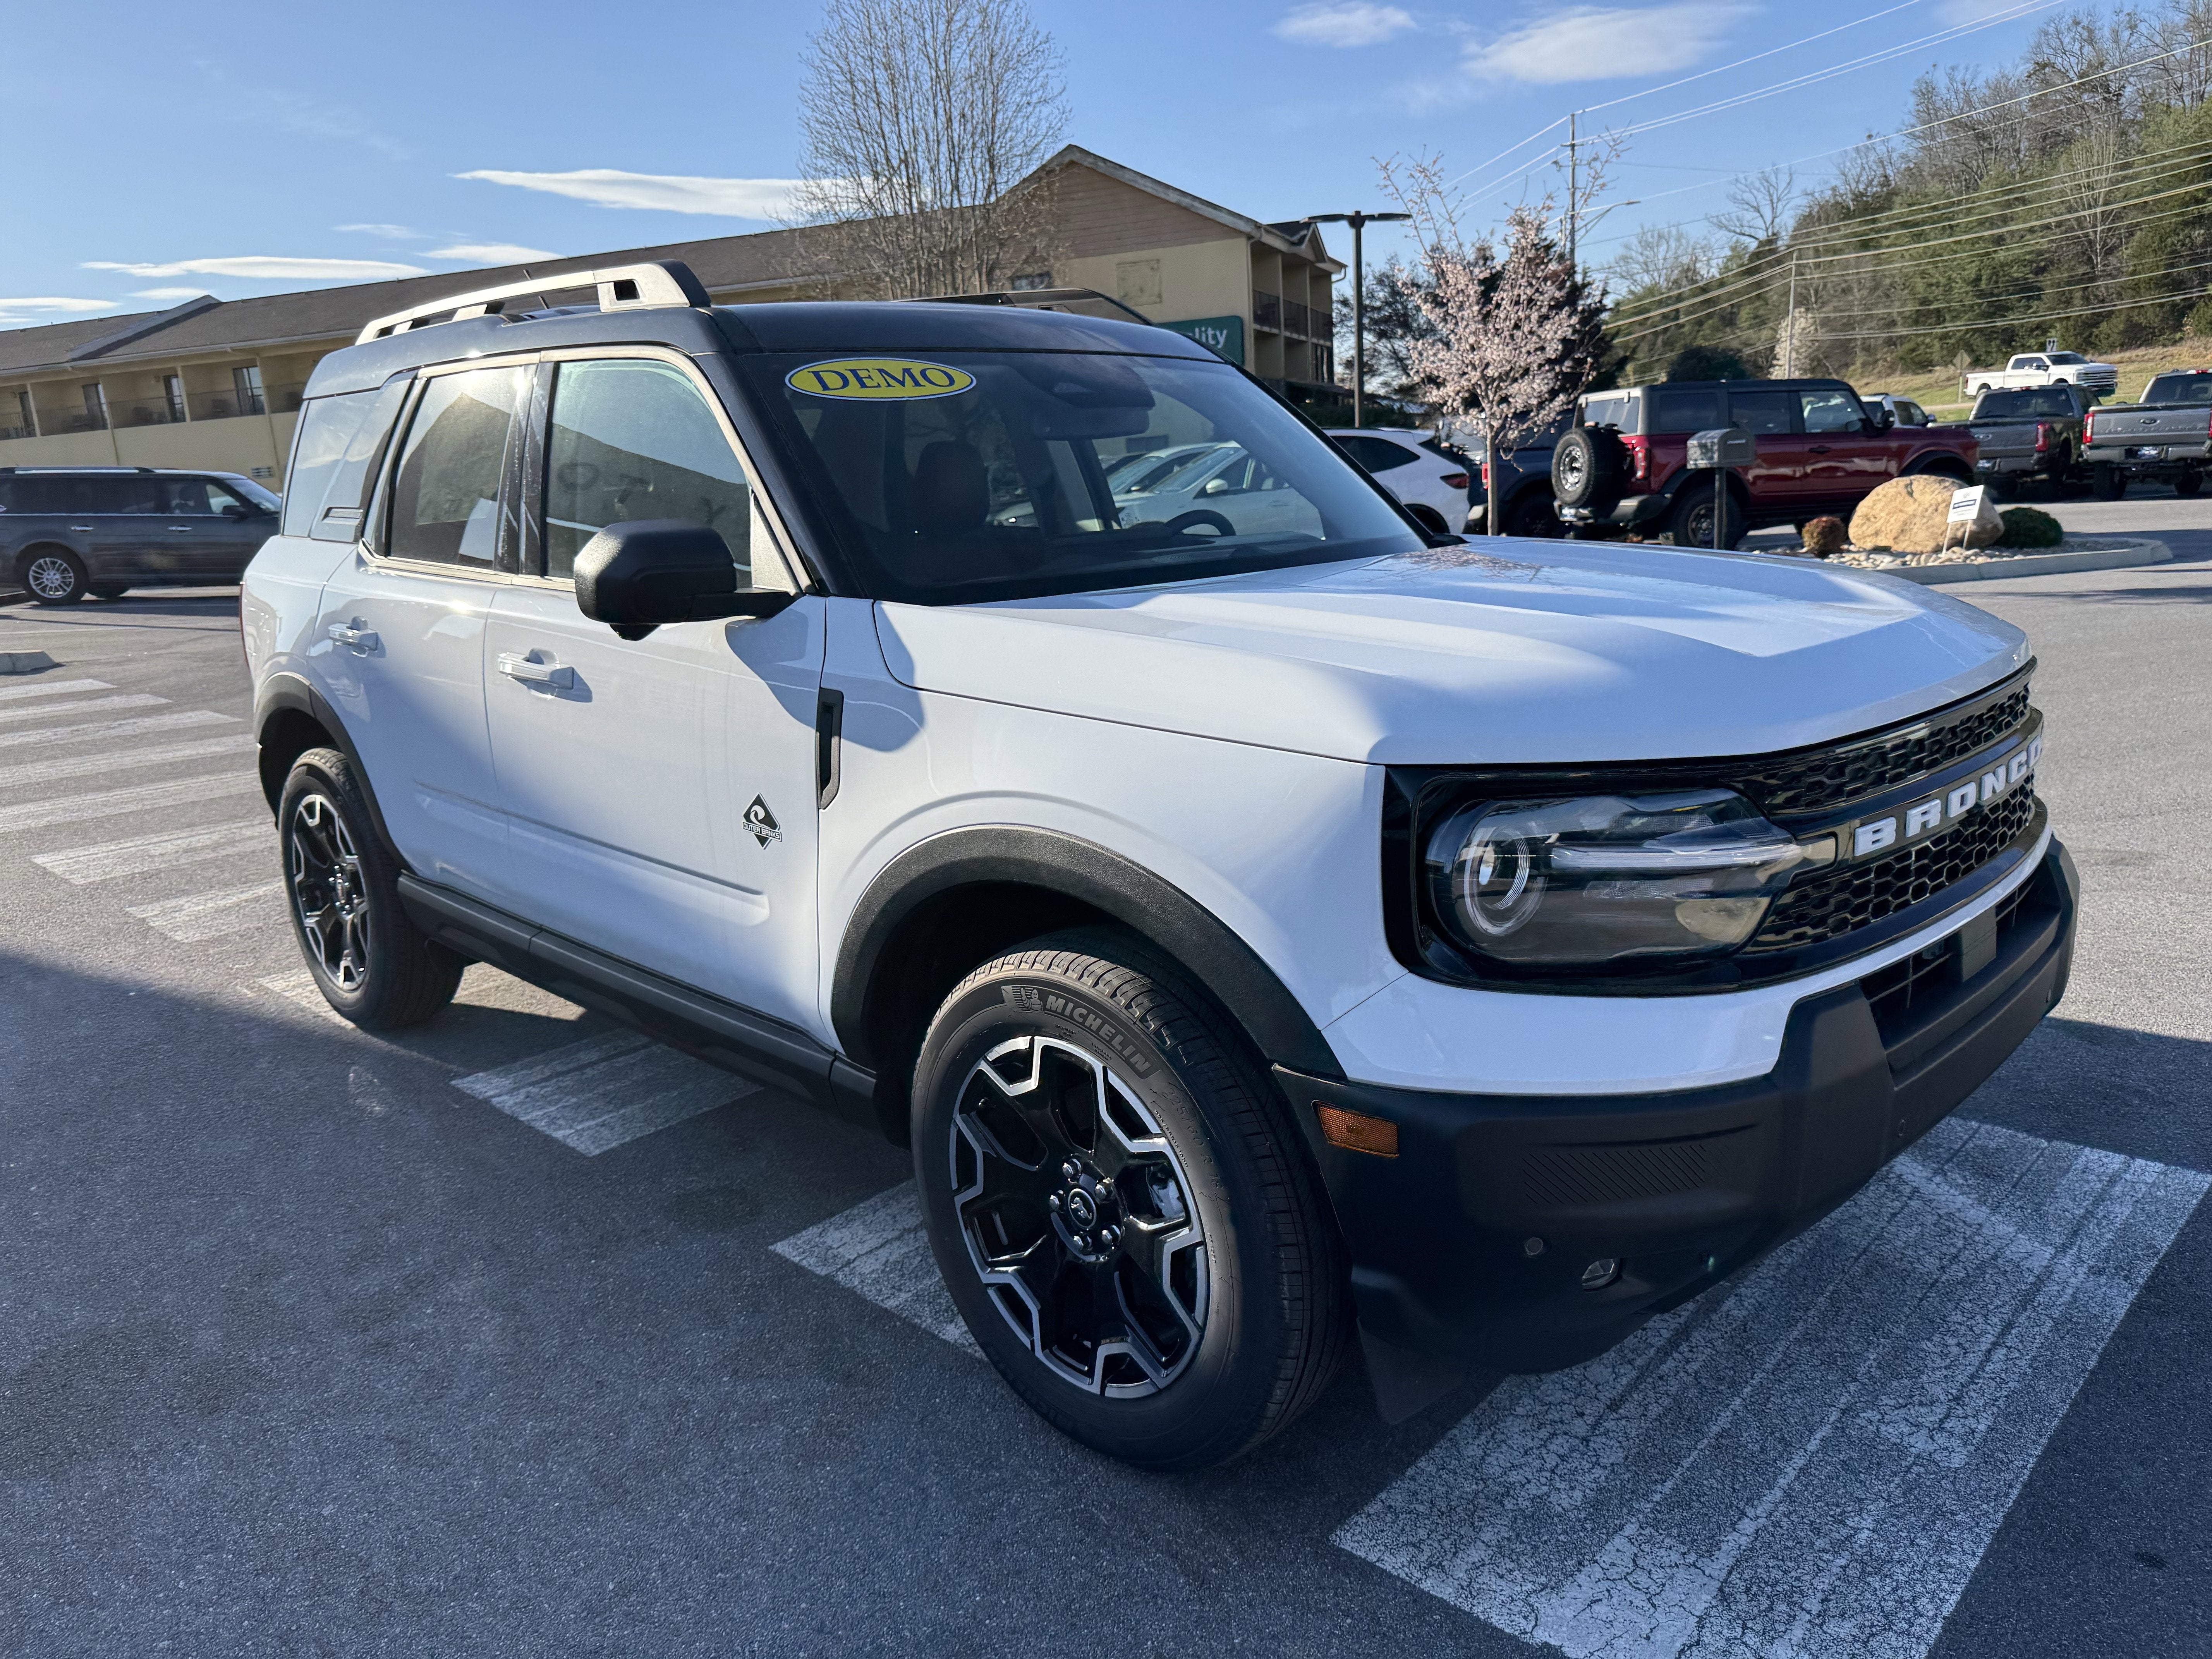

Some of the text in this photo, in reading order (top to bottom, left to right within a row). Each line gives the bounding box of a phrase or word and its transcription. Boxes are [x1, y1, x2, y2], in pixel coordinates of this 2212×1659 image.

[1187, 326, 1228, 349] lity
[808, 368, 956, 391] DEMO
[1854, 736, 2042, 857] BRONCO
[744, 823, 780, 839] OUTER BANKS
[1046, 994, 1151, 1073] MICHELIN
